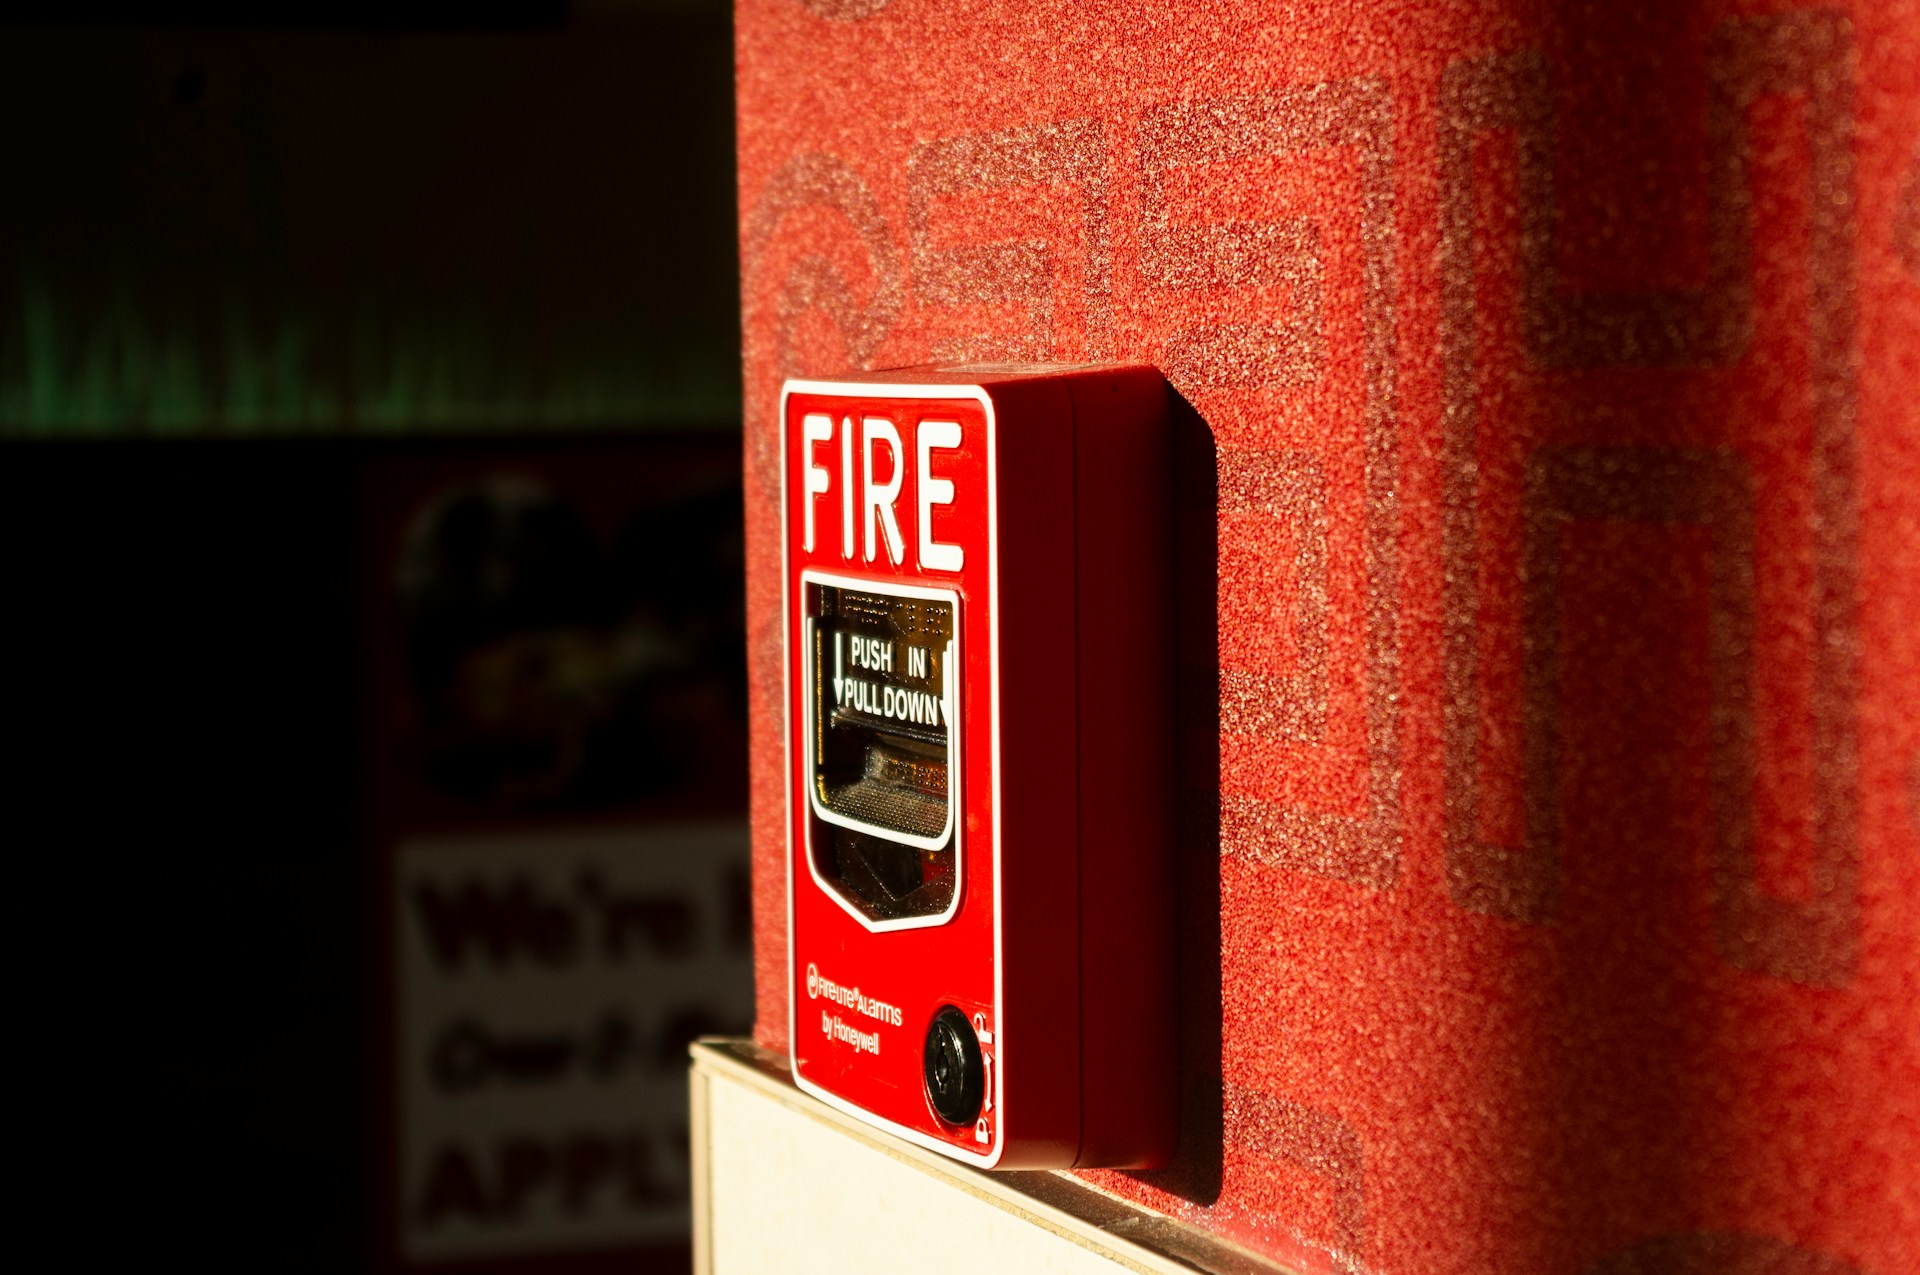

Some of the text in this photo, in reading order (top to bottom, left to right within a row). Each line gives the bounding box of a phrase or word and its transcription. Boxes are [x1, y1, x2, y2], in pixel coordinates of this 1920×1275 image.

[803, 414, 964, 572] FIRE
[851, 636, 925, 679] PUSH IN
[845, 678, 937, 726] PULL DOWN
[822, 1010, 879, 1055] by Honeywell
